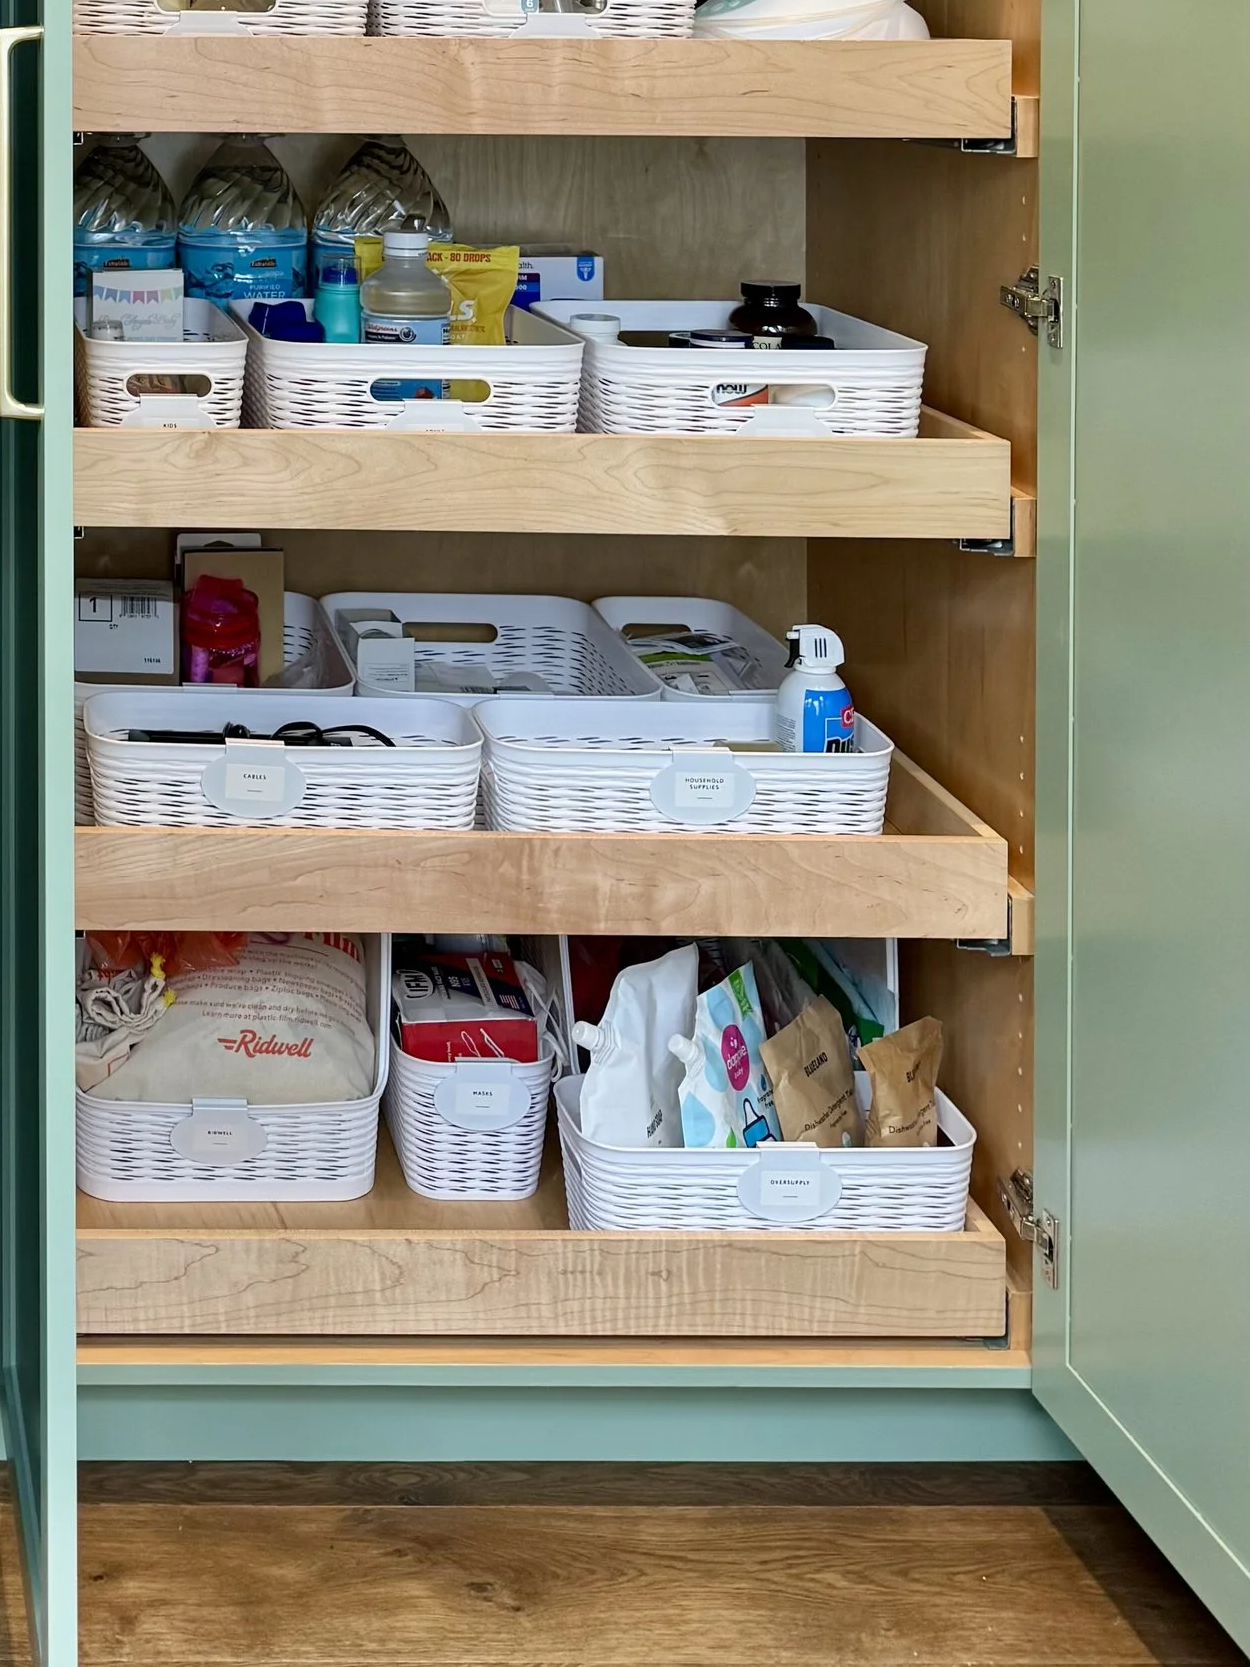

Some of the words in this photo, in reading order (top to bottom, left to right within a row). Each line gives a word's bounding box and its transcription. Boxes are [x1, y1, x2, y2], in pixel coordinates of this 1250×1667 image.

[450, 253, 462, 262] 80
[463, 252, 491, 262] DROPS
[90, 596, 96, 613] 1
[252, 976, 270, 984] bags
[244, 984, 263, 992] bags
[270, 986, 296, 994] Ziploc
[202, 1010, 222, 1019] Learn
[268, 1004, 282, 1012] and
[282, 1004, 295, 1015] dry
[235, 1029, 314, 1058] Ridwell
[726, 1046, 747, 1070] dapple
[804, 1051, 828, 1078] BLUELAND
